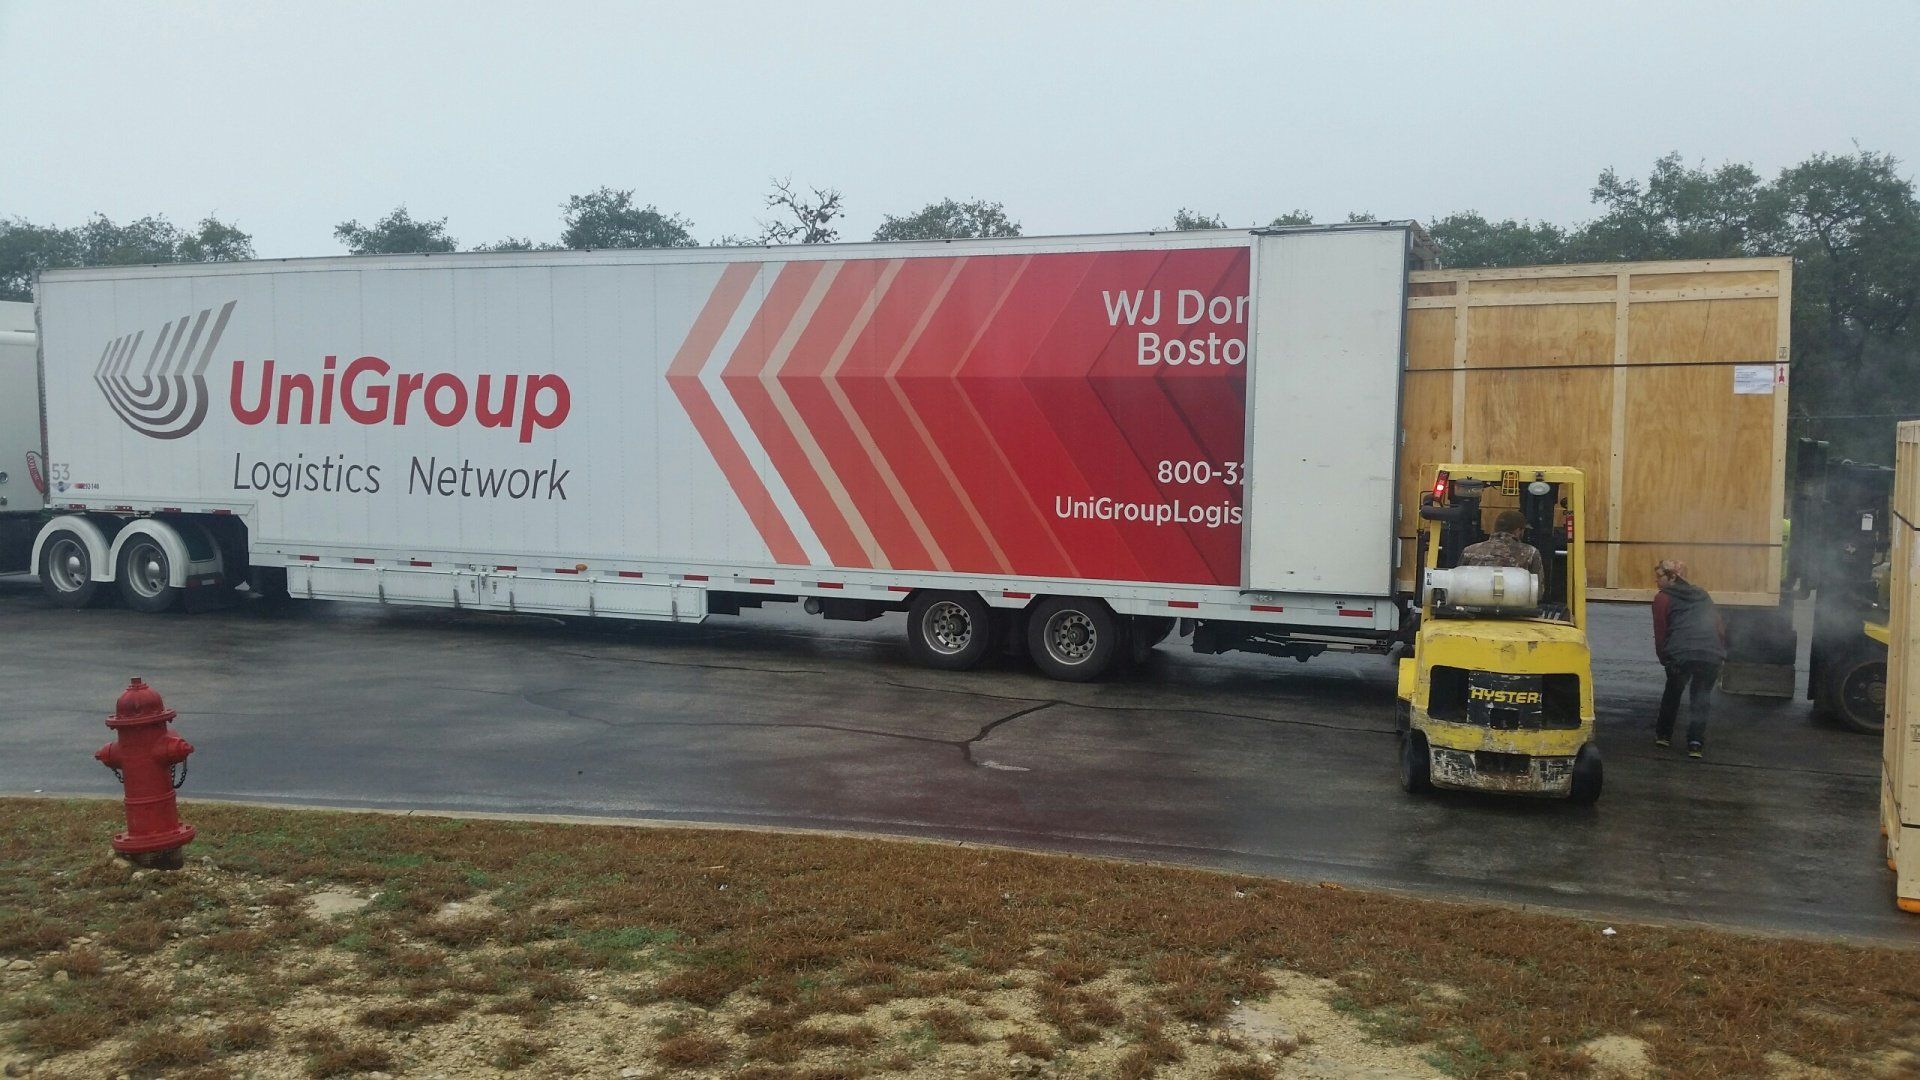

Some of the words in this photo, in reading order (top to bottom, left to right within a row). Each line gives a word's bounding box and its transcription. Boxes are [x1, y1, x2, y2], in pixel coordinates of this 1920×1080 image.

[1102, 289, 1161, 326] WJ
[1137, 332, 1246, 366] Bosto
[230, 355, 571, 443] UniGroup
[52, 463, 71, 480] 53
[233, 452, 381, 498] Logistics
[409, 456, 570, 500] Network
[1055, 496, 1243, 528] UniGroupLogis
[1470, 688, 1539, 704] HYSTER
